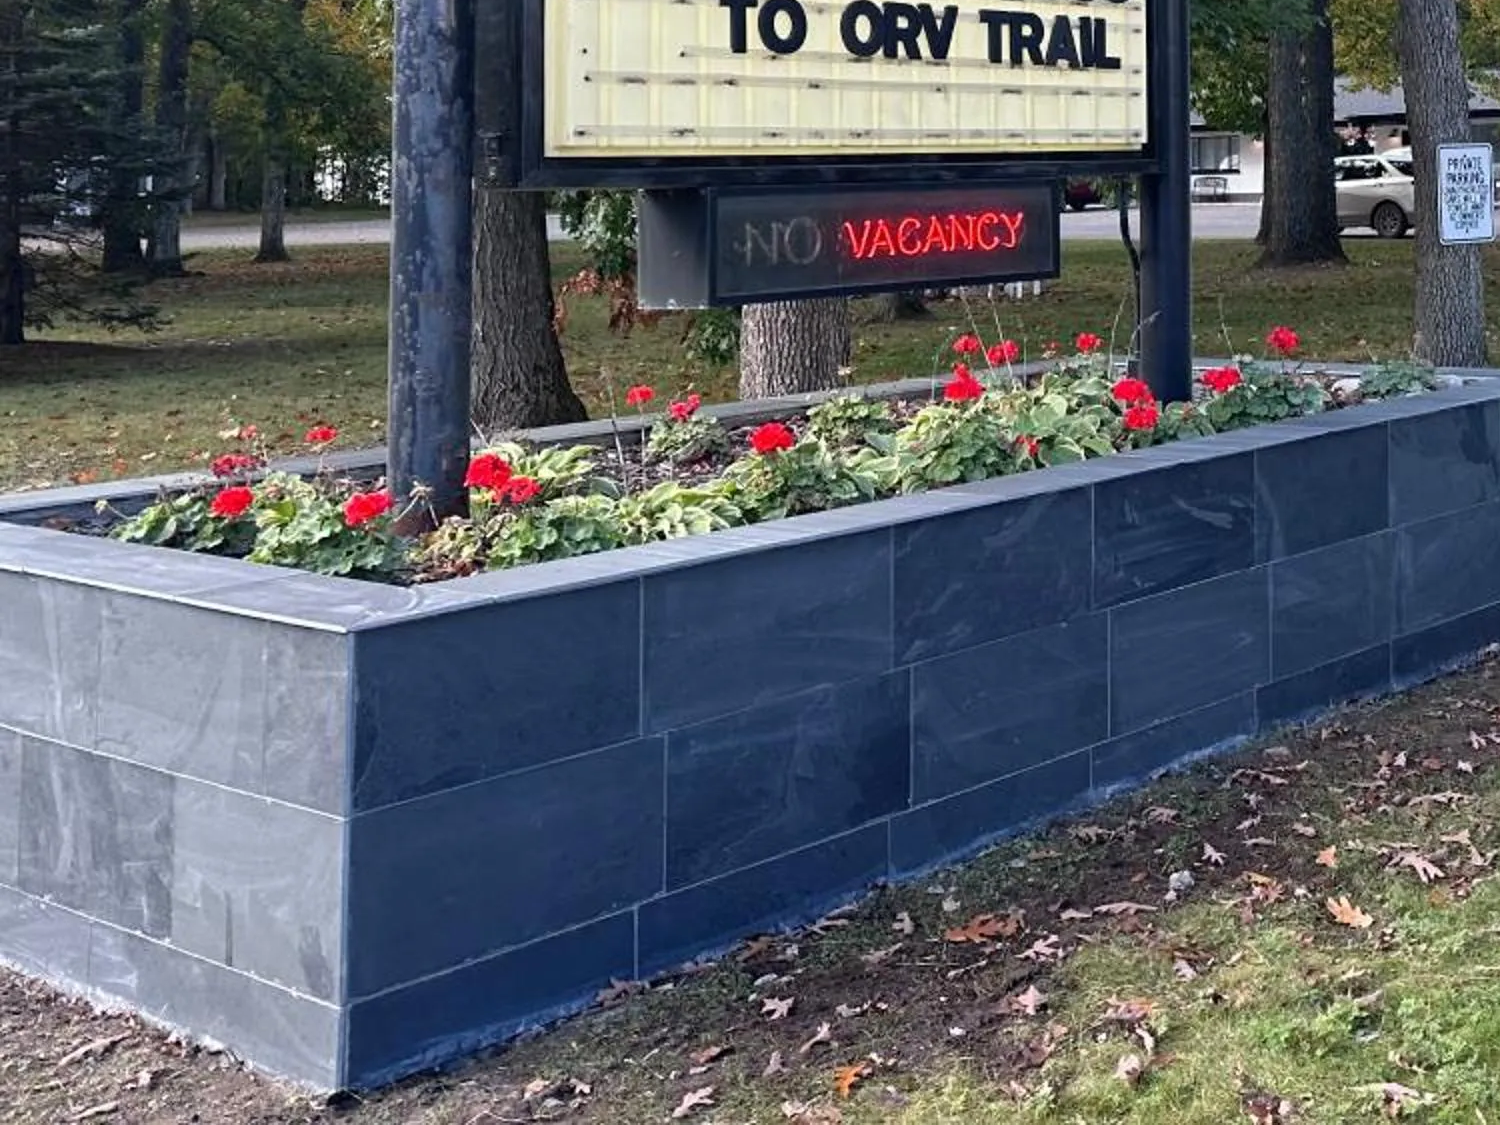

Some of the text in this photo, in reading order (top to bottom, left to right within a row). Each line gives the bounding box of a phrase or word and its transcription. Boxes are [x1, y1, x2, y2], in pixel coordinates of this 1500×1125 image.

[979, 9, 1122, 70] TRAIL
[735, 211, 1024, 266] NO VACANCY
